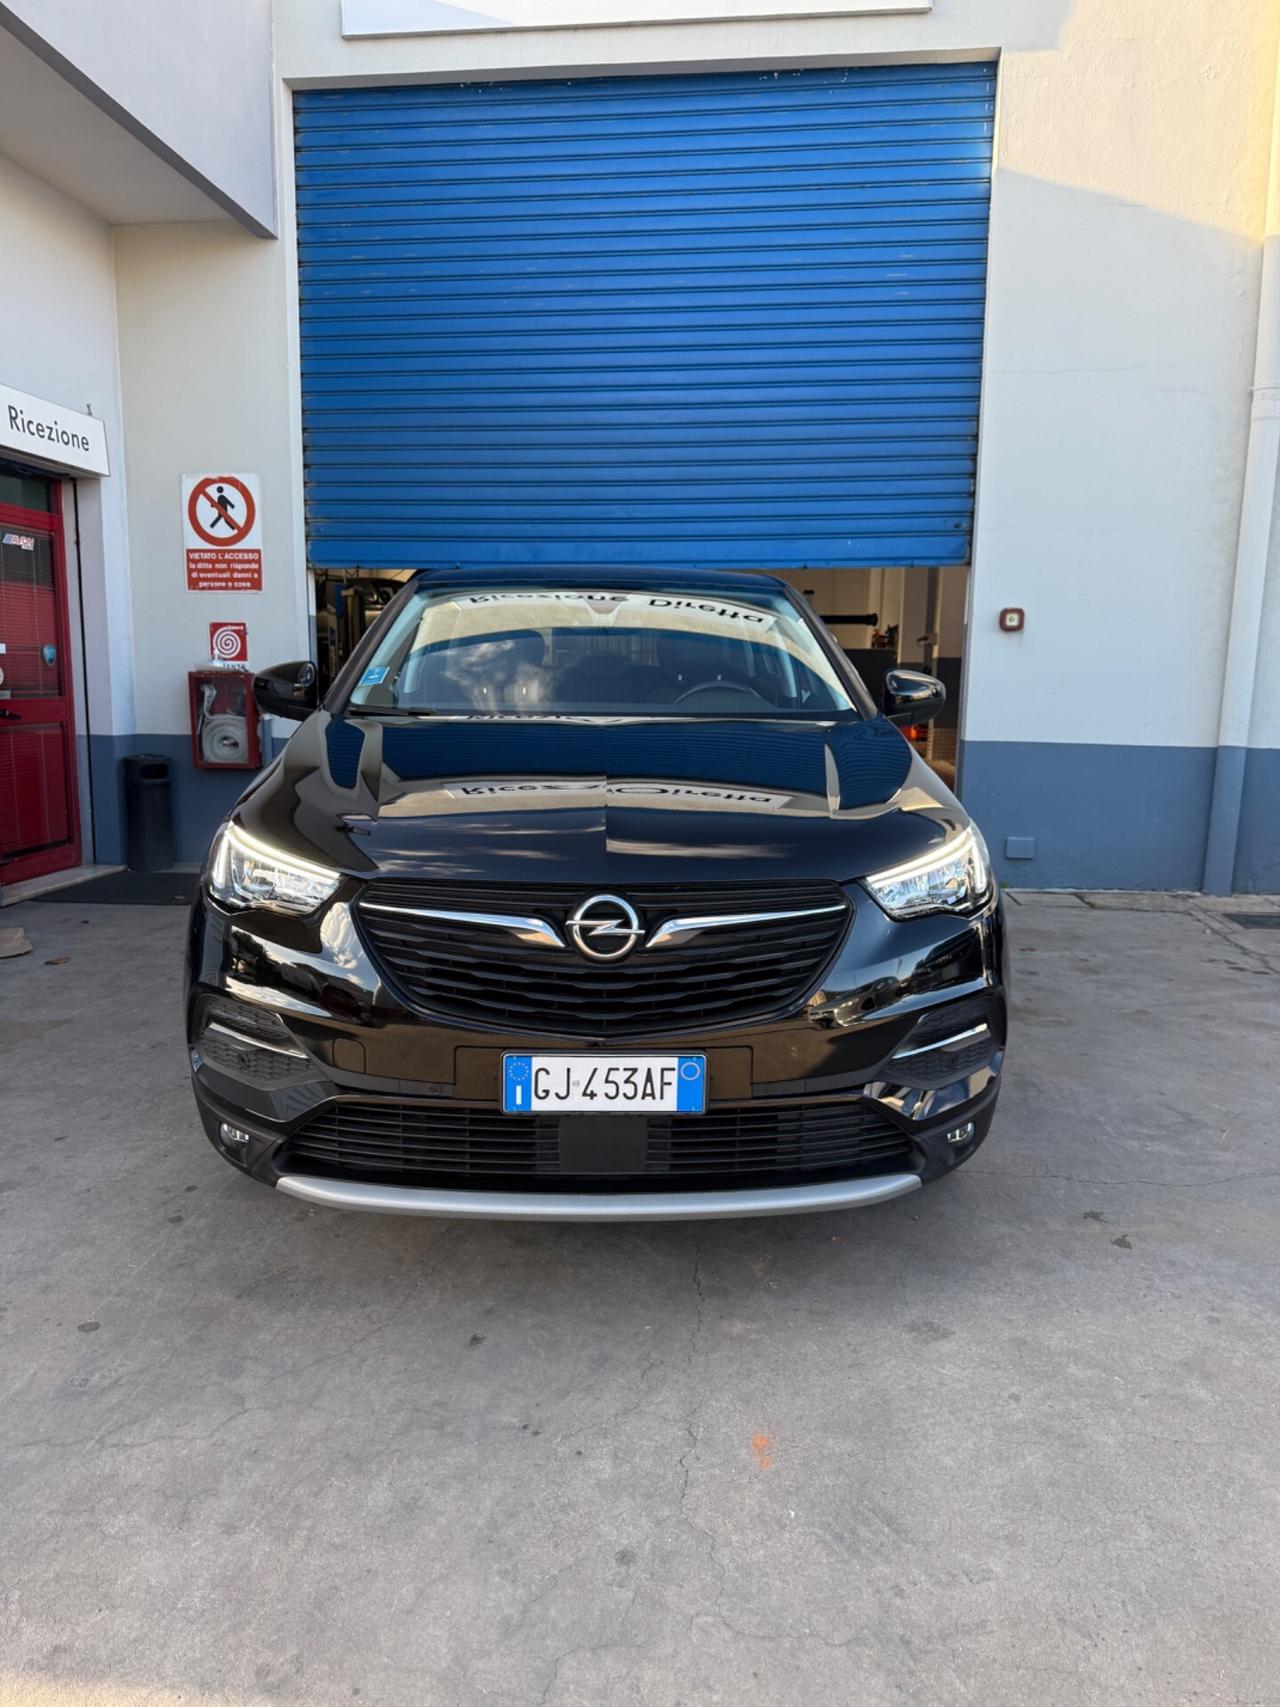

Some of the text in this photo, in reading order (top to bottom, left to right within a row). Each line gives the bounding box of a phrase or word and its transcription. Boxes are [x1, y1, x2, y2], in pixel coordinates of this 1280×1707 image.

[8, 404, 89, 452] Ricezione
[188, 552, 217, 560] VIETATO
[229, 562, 259, 570] risponde
